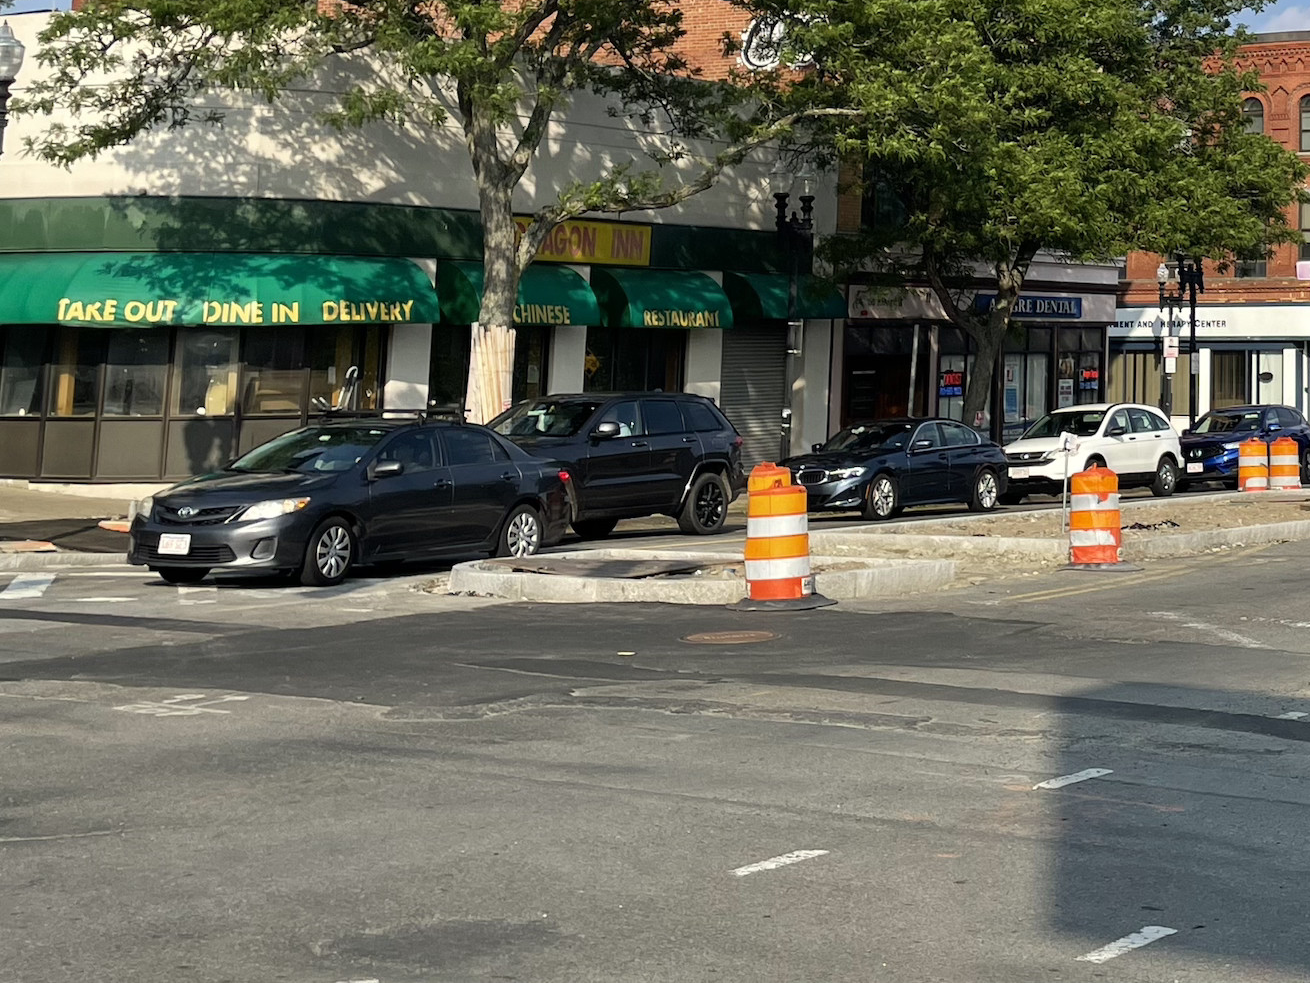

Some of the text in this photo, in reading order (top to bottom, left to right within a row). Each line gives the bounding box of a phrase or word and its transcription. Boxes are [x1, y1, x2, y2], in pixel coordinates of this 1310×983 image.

[514, 221, 643, 260] AGON INN
[58, 298, 177, 323] TAKE OUT
[202, 301, 299, 323] DINE IN
[322, 299, 414, 322] DELIVERY
[513, 304, 571, 325] CHINESE
[988, 298, 1077, 315] AGRE DENTAL
[643, 309, 720, 327] RESTAURANT
[1137, 320, 1154, 328] AND
[1194, 319, 1226, 328] CENTER
